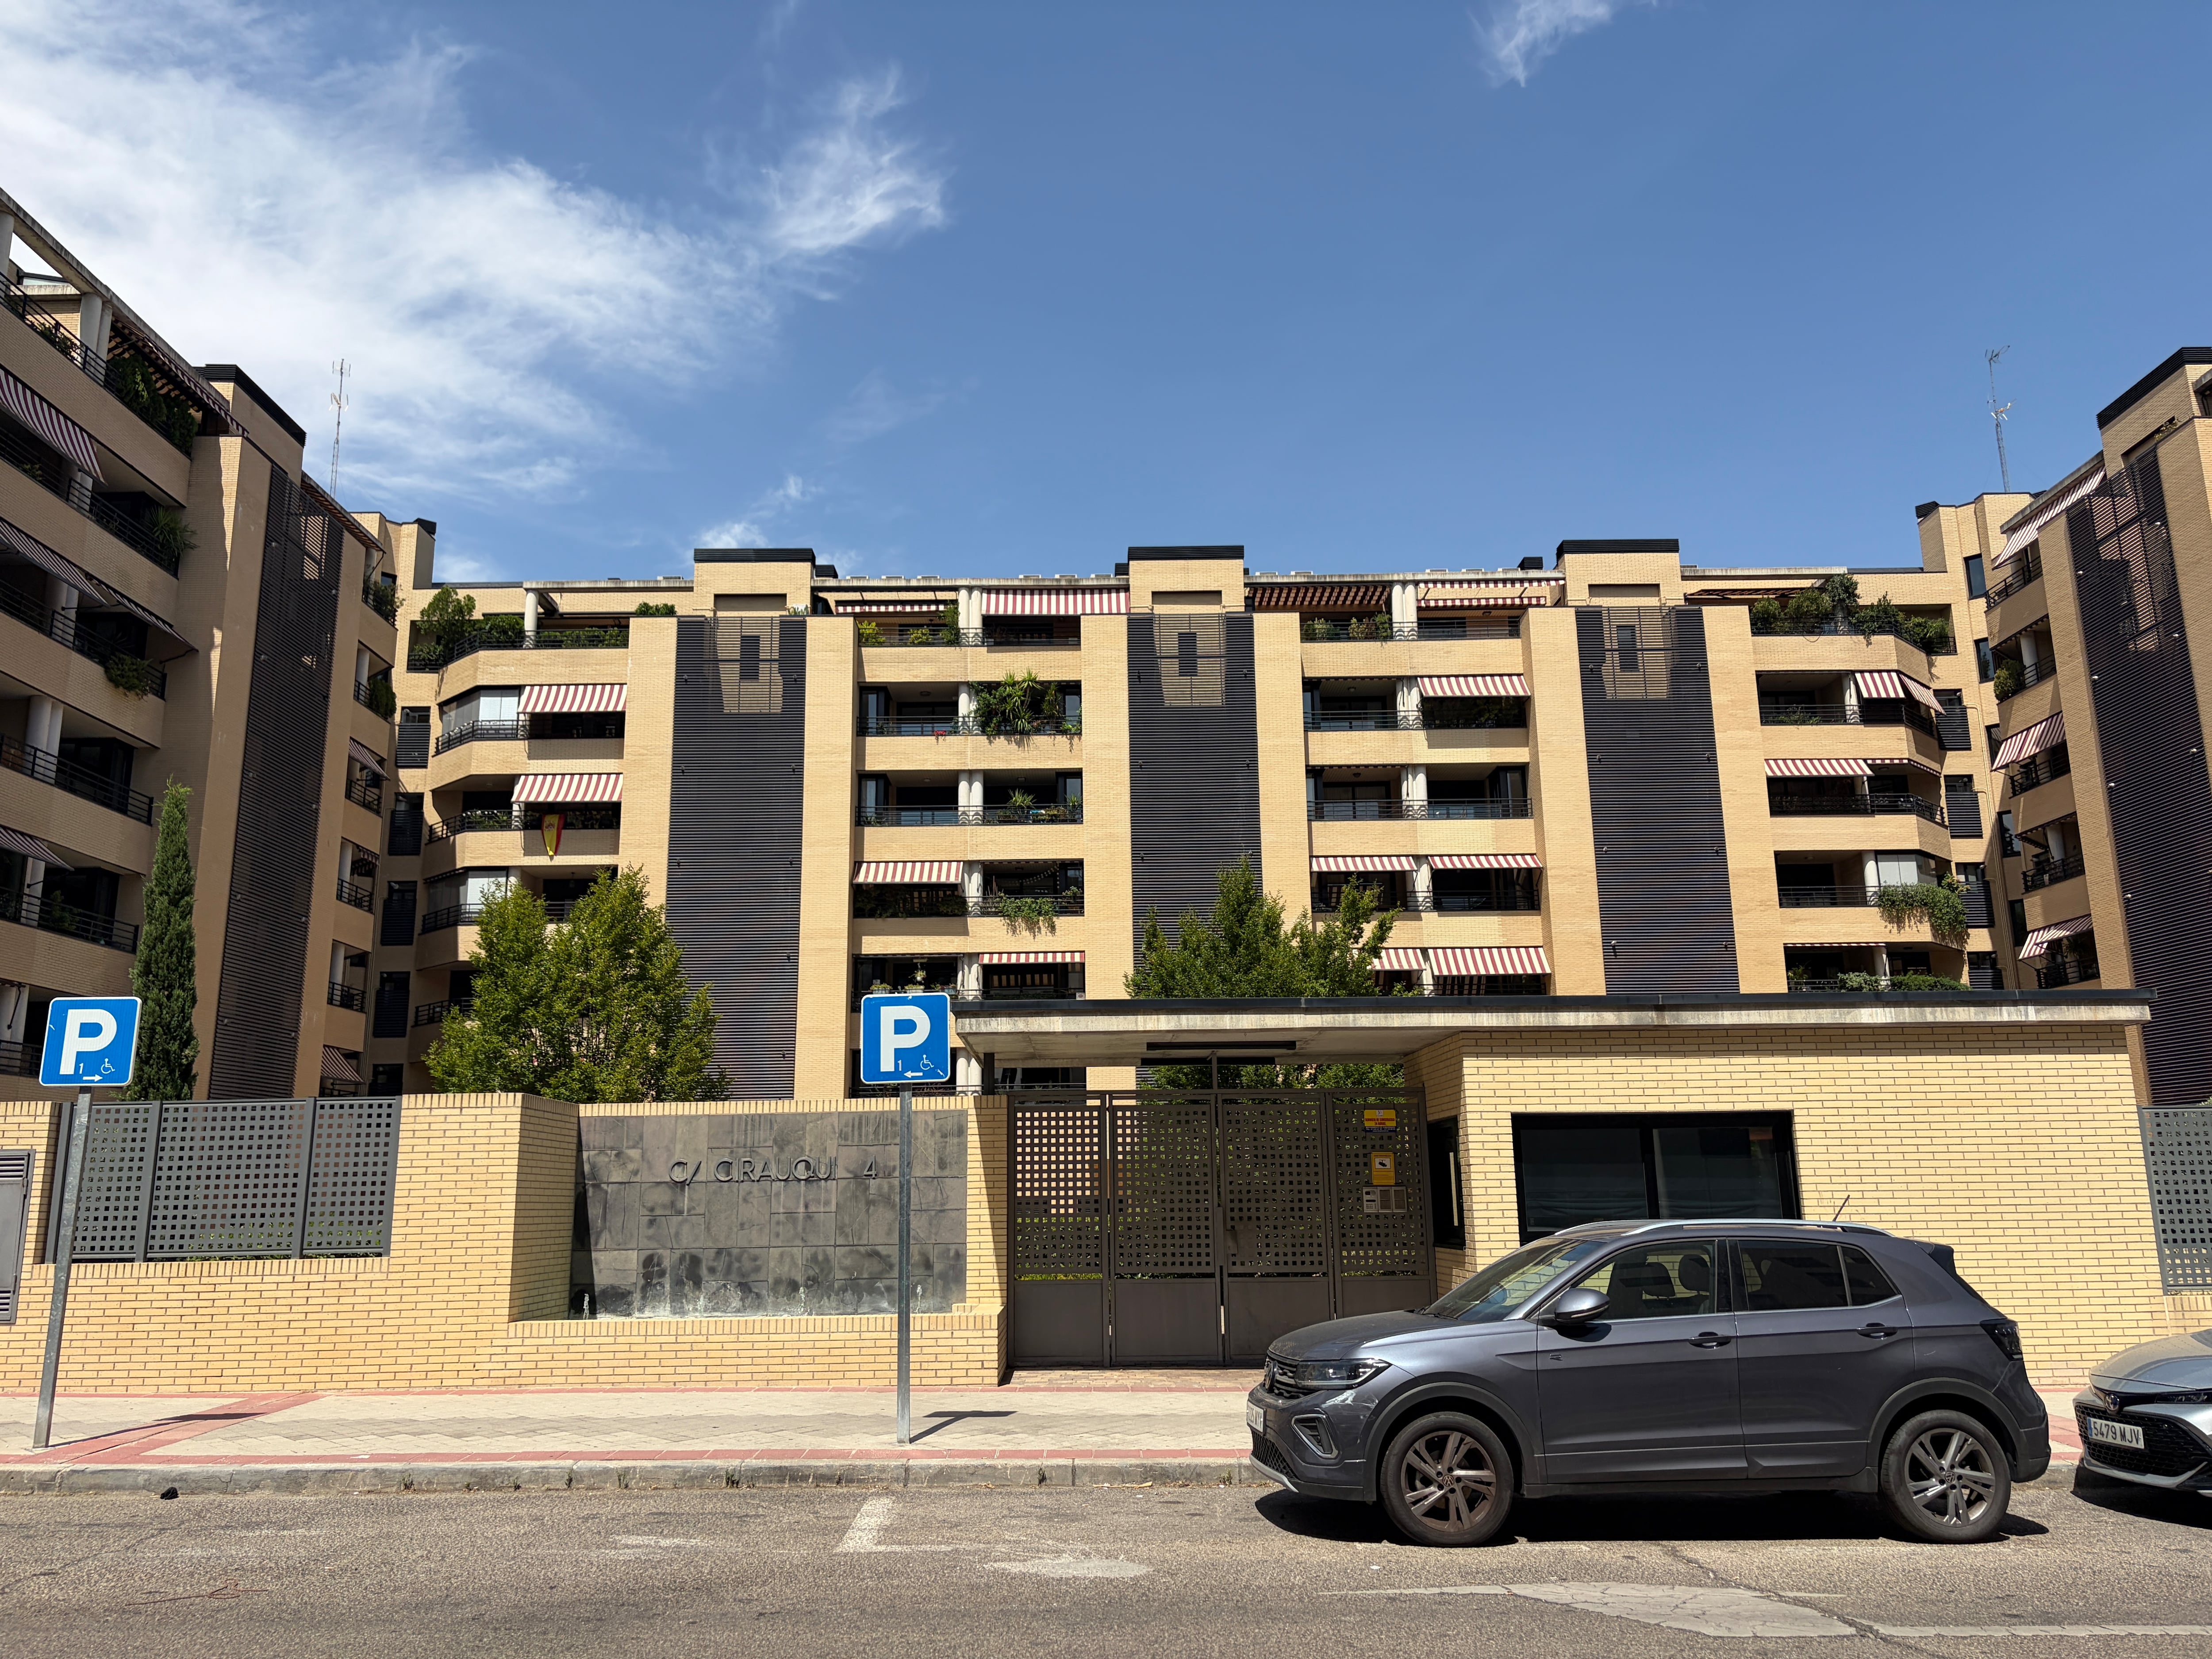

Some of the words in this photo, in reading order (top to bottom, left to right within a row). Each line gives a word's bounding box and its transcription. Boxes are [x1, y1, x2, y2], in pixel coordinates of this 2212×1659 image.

[59, 1009, 117, 1075] P
[880, 1006, 931, 1071] P
[79, 1063, 84, 1074] 1
[897, 1060, 902, 1071] 1
[668, 1158, 702, 1186] C/
[714, 1156, 837, 1183] CIRAUQUI
[863, 1155, 877, 1179] 4
[2093, 1421, 2117, 1440] 5479
[2120, 1426, 2139, 1445] MJV
